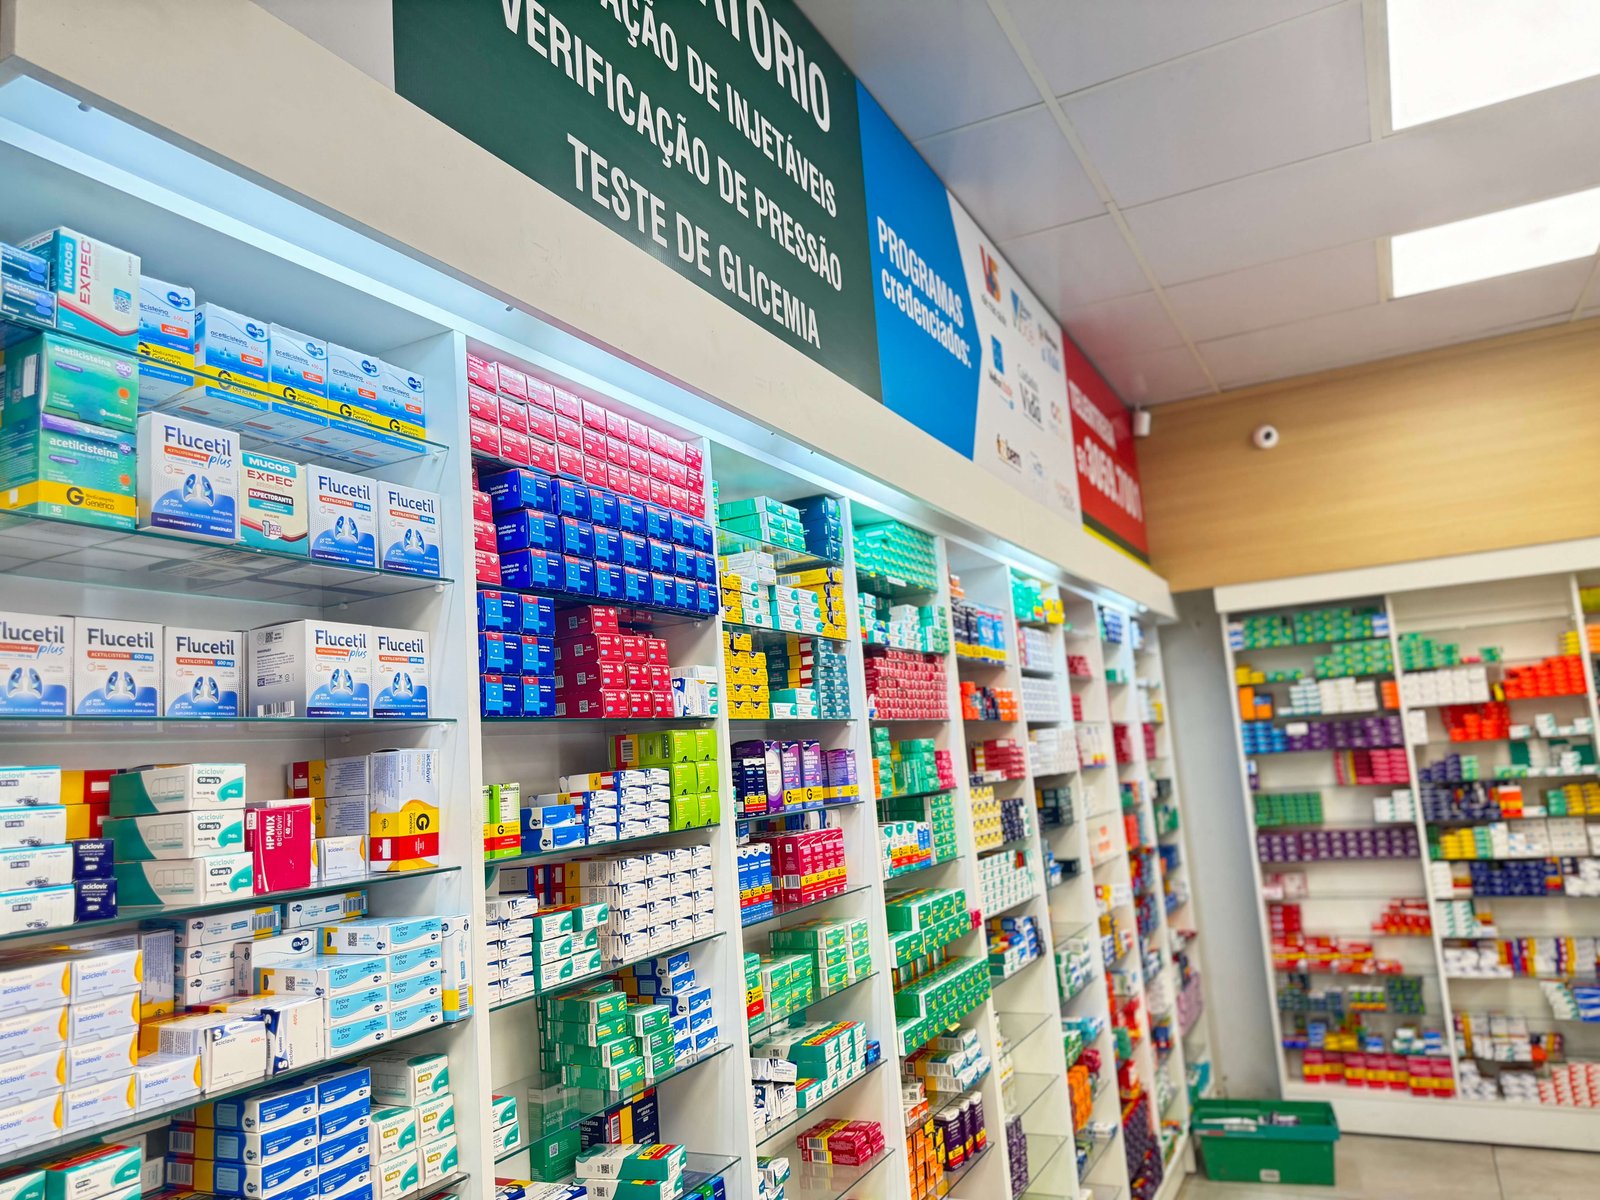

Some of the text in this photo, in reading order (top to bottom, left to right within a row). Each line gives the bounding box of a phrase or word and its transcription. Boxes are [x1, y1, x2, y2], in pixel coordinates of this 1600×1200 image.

[687, 45, 720, 113] DE
[726, 83, 837, 218] INJETÁVEIS
[503, 0, 843, 292] VERIFICAÇÃO DE PRESSÃO
[567, 133, 821, 350] TESTE DE GLICEMIA
[63, 242, 74, 289] MUCOS
[80, 240, 92, 305] EXPEC
[877, 215, 965, 329] PROGRAMAS
[164, 425, 232, 457] Flucetil
[208, 452, 232, 469] plus
[248, 456, 291, 474] MUCOS
[247, 469, 294, 488] EXPEC
[318, 475, 371, 501] Flucetil
[66, 487, 84, 505] G
[249, 489, 293, 505] EXPECTORANTE
[388, 490, 435, 514] Flucetil
[87, 628, 154, 649] Flucetil
[176, 636, 235, 656] Flucetil
[315, 629, 367, 649] Flucetil
[378, 635, 424, 654] Flucetil
[36, 642, 65, 659] plus
[349, 646, 367, 661] plus
[197, 767, 225, 775] aciclovir
[786, 790, 792, 803] G
[806, 788, 813, 800] G
[197, 813, 225, 821] aciclovir
[415, 813, 430, 831] G
[265, 815, 276, 850] HPMIX
[497, 824, 505, 835] G
[209, 859, 235, 867] aciclovir
[394, 953, 408, 961] Febre
[82, 969, 109, 980] aciclovir
[338, 973, 348, 981] Dor
[3, 984, 32, 995] aciclovir
[79, 1012, 105, 1023] aciclovir
[215, 1036, 260, 1047] aciclovir 400
[76, 1055, 102, 1066] aciclovir
[417, 1064, 439, 1074] adapaleno
[145, 1077, 169, 1089] aciclovir
[72, 1098, 98, 1110] aciclovir
[422, 1103, 444, 1113] adapaleno
[382, 1117, 406, 1130] adapaleno
[426, 1143, 447, 1154] adapaleno
[384, 1159, 407, 1172] adapaleno
